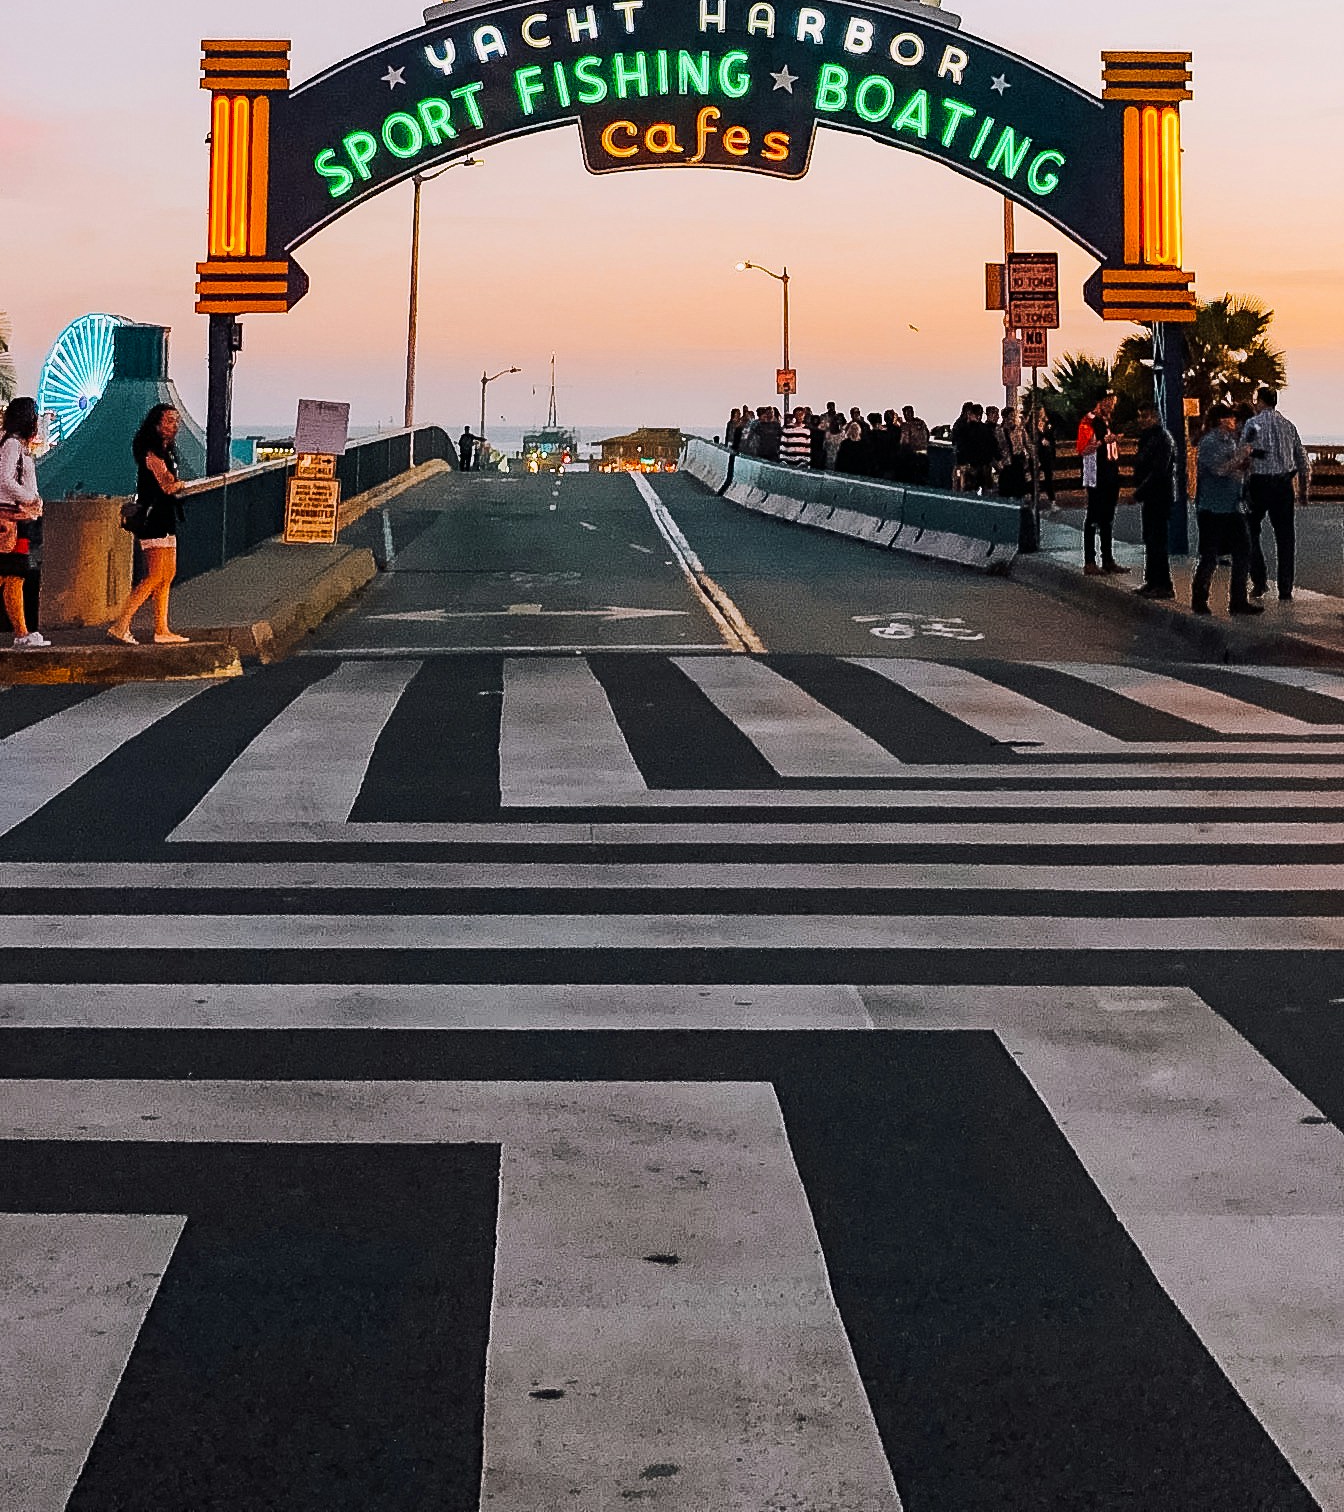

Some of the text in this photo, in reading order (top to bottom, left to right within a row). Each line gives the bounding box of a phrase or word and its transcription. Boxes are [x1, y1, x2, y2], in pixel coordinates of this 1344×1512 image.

[424, 0, 970, 86] YACHT HARBOR
[313, 49, 1066, 199] SPORT FISHING BOATING
[601, 105, 792, 164] cafes
[1027, 276, 1054, 288] TONS
[1026, 331, 1043, 345] NO
